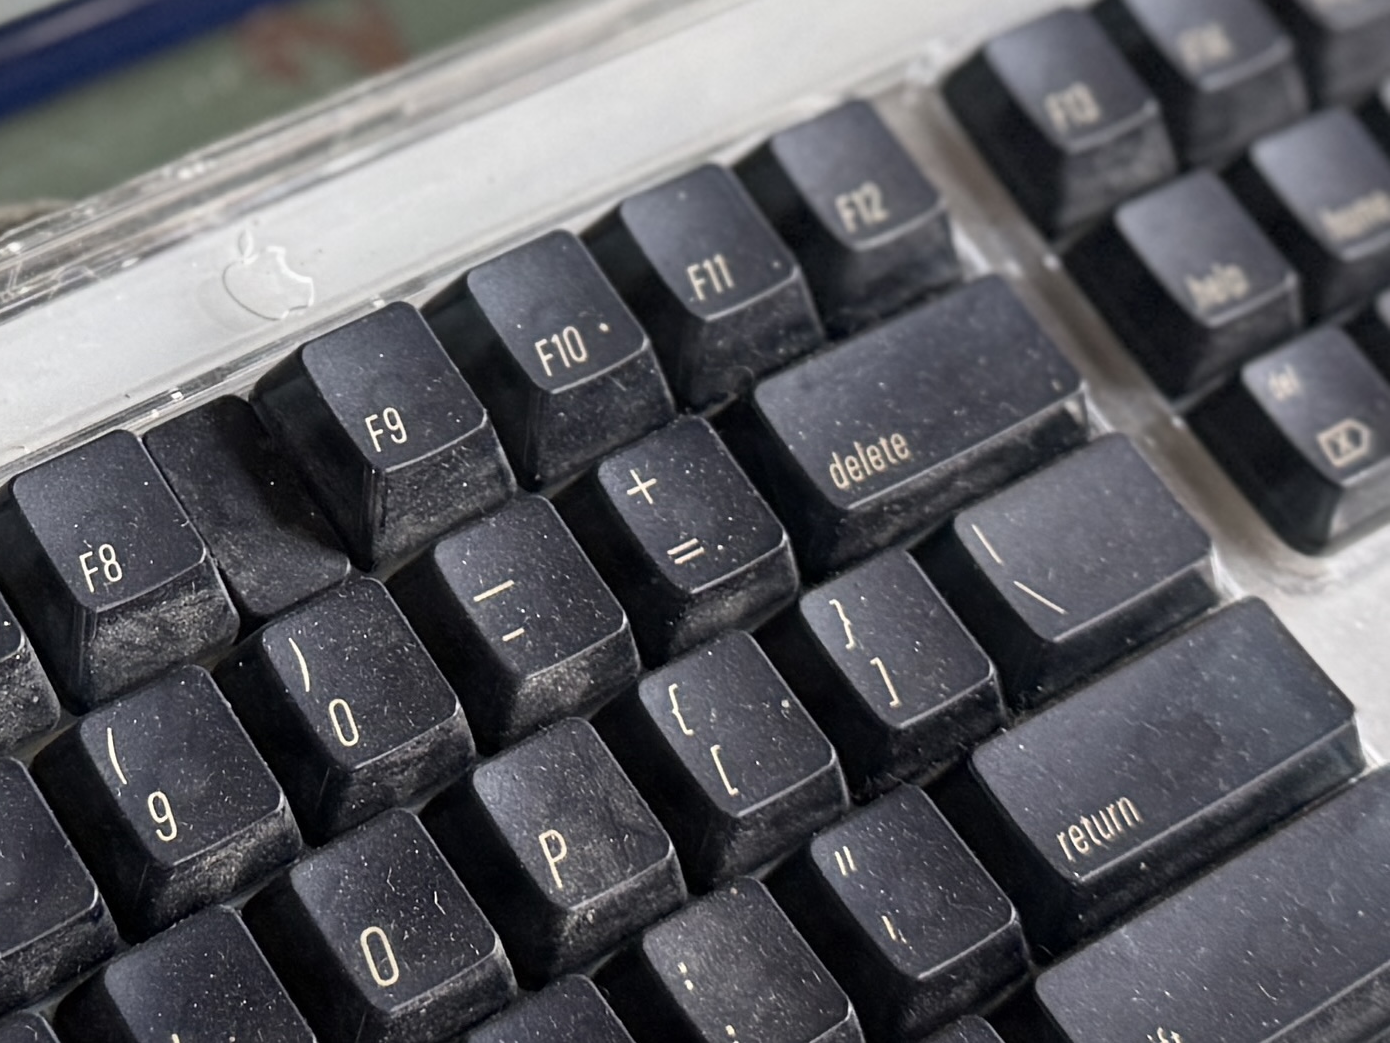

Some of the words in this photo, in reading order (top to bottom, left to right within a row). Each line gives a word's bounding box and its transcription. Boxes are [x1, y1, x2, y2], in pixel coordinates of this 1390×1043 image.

[835, 182, 889, 234] F12
[686, 254, 733, 301] F11
[534, 326, 588, 377] F10
[364, 407, 408, 453] F9
[626, 469, 657, 505] +
[828, 432, 911, 491] delete
[78, 543, 123, 593] F8
[666, 537, 705, 565] =
[828, 598, 855, 650] }
[288, 637, 310, 693] )
[869, 657, 900, 707] ]
[328, 698, 360, 747] 0
[668, 683, 694, 736] {
[106, 727, 128, 785] (
[709, 744, 739, 796] [
[147, 790, 178, 842] 9
[1056, 796, 1143, 862] return
[538, 829, 568, 890] P
